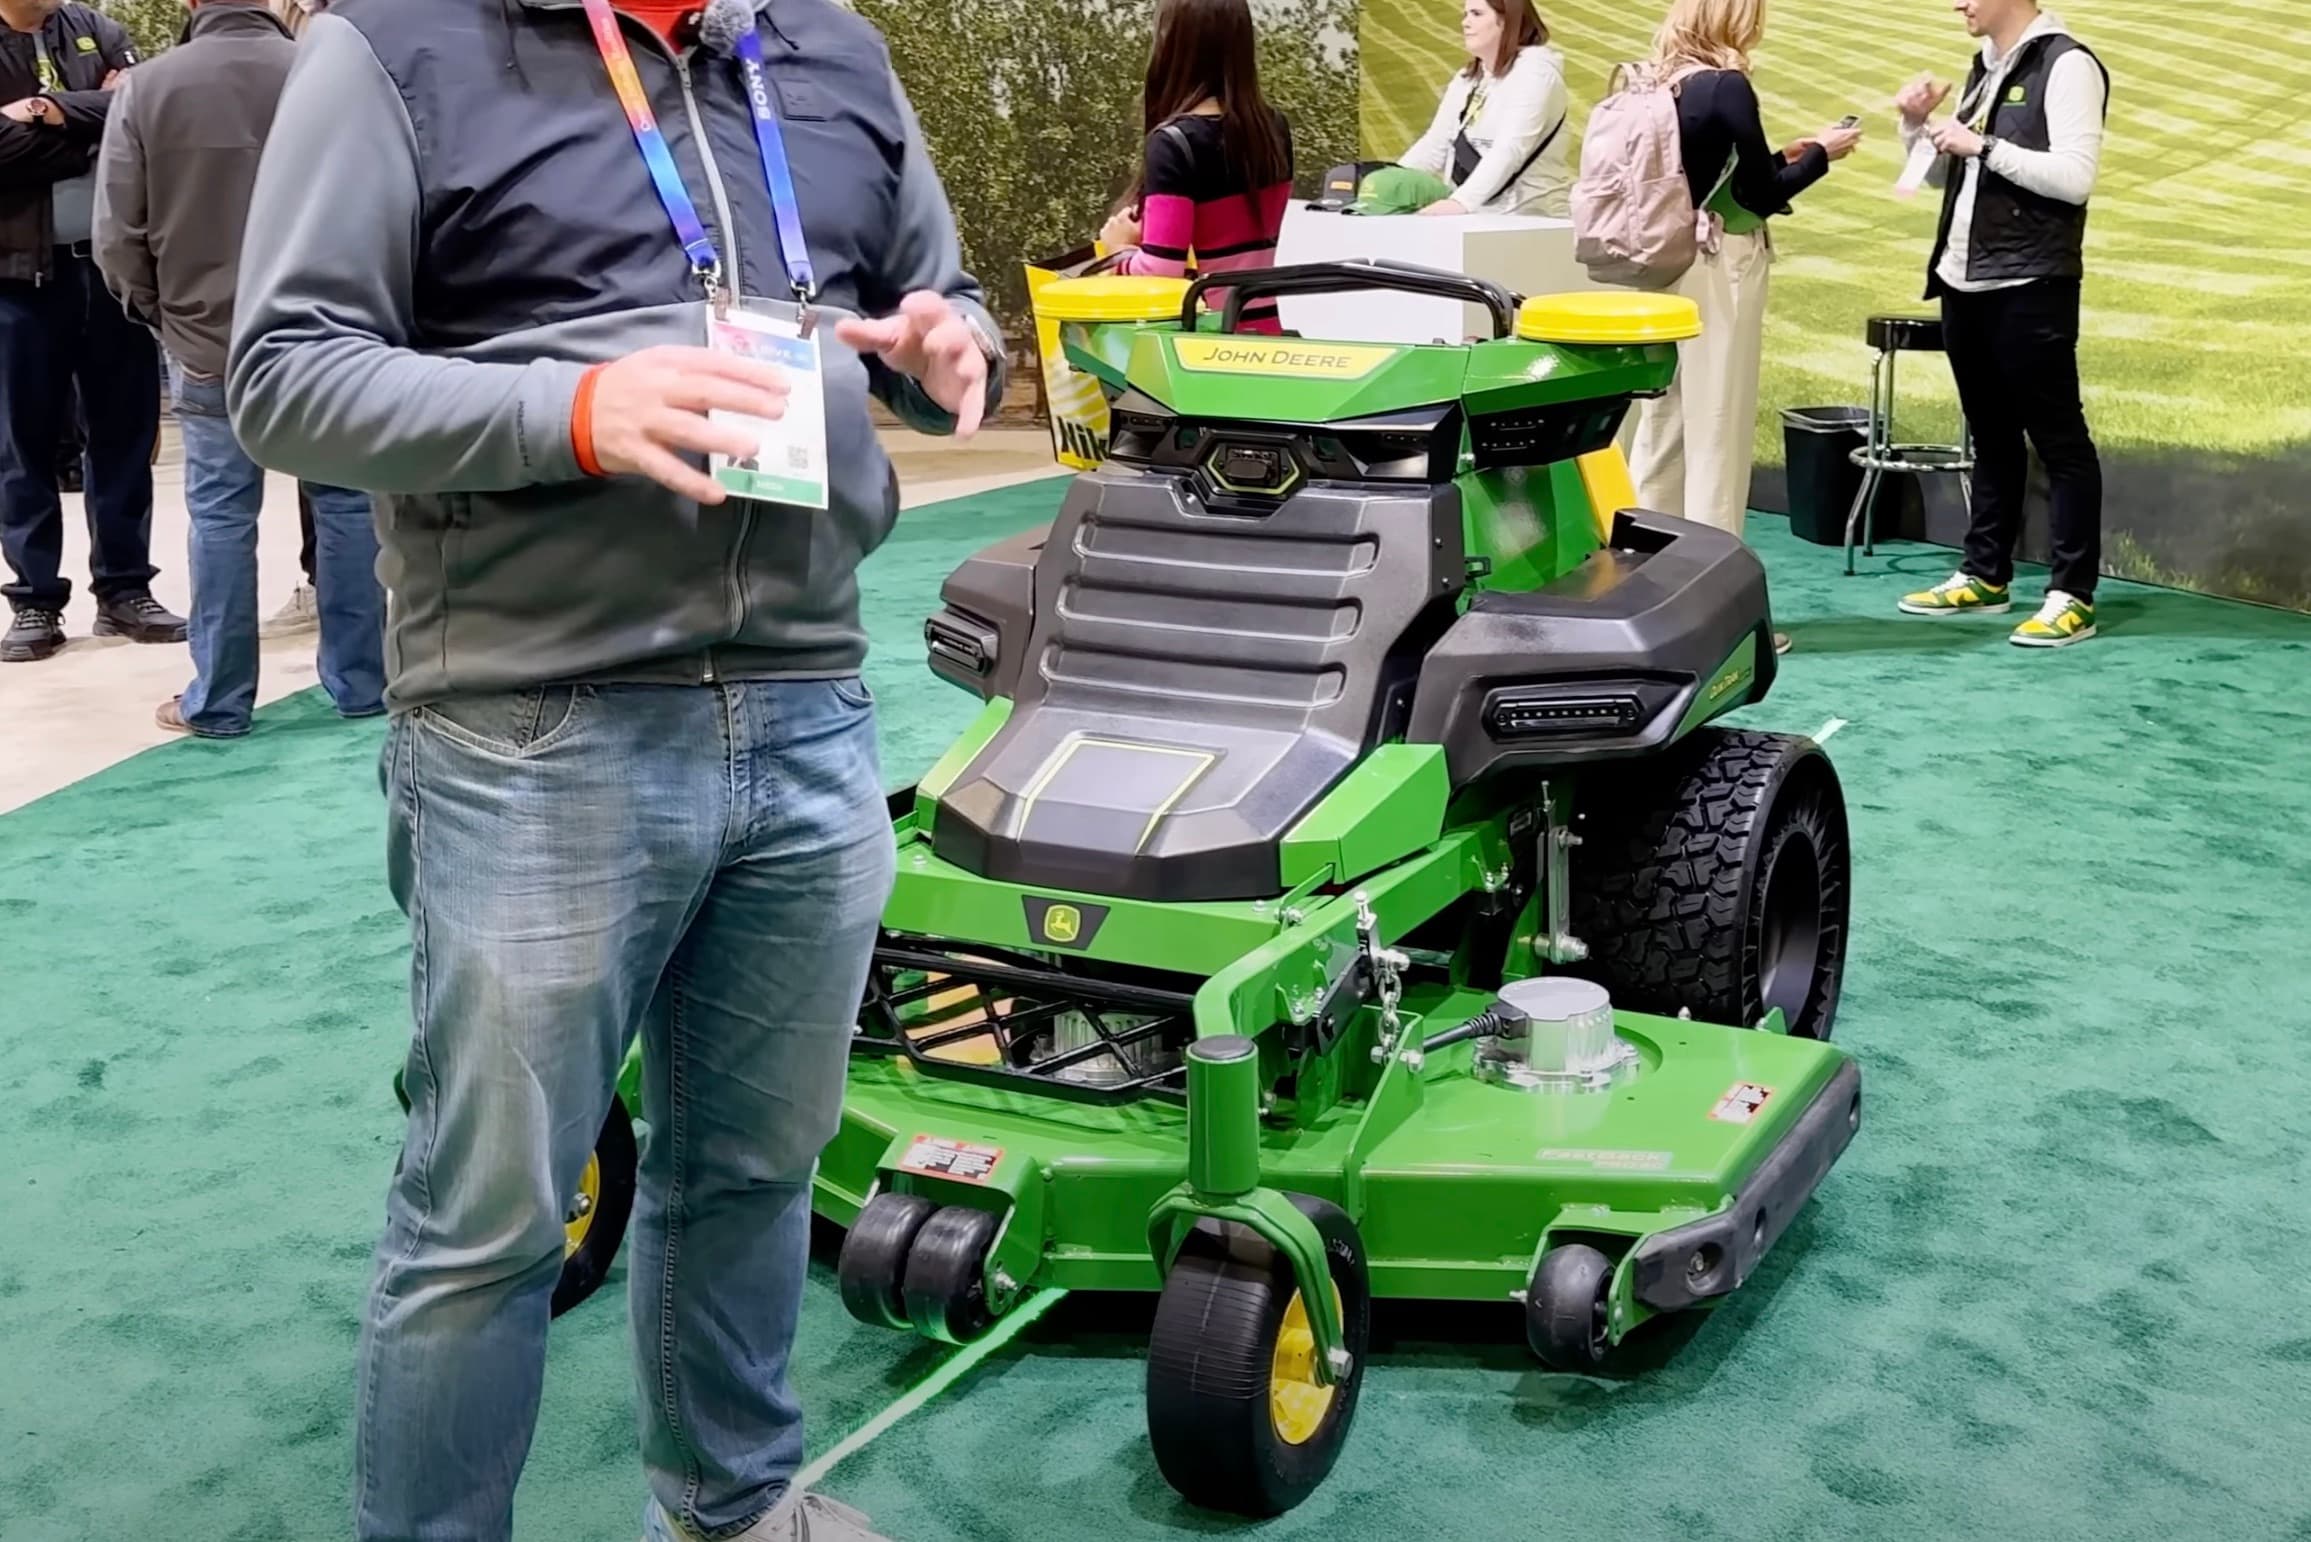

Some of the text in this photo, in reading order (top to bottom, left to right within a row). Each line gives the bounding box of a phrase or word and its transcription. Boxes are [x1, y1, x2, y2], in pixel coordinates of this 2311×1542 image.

[745, 57, 771, 120] SONY
[1203, 347, 1353, 369] JOHN DEERE
